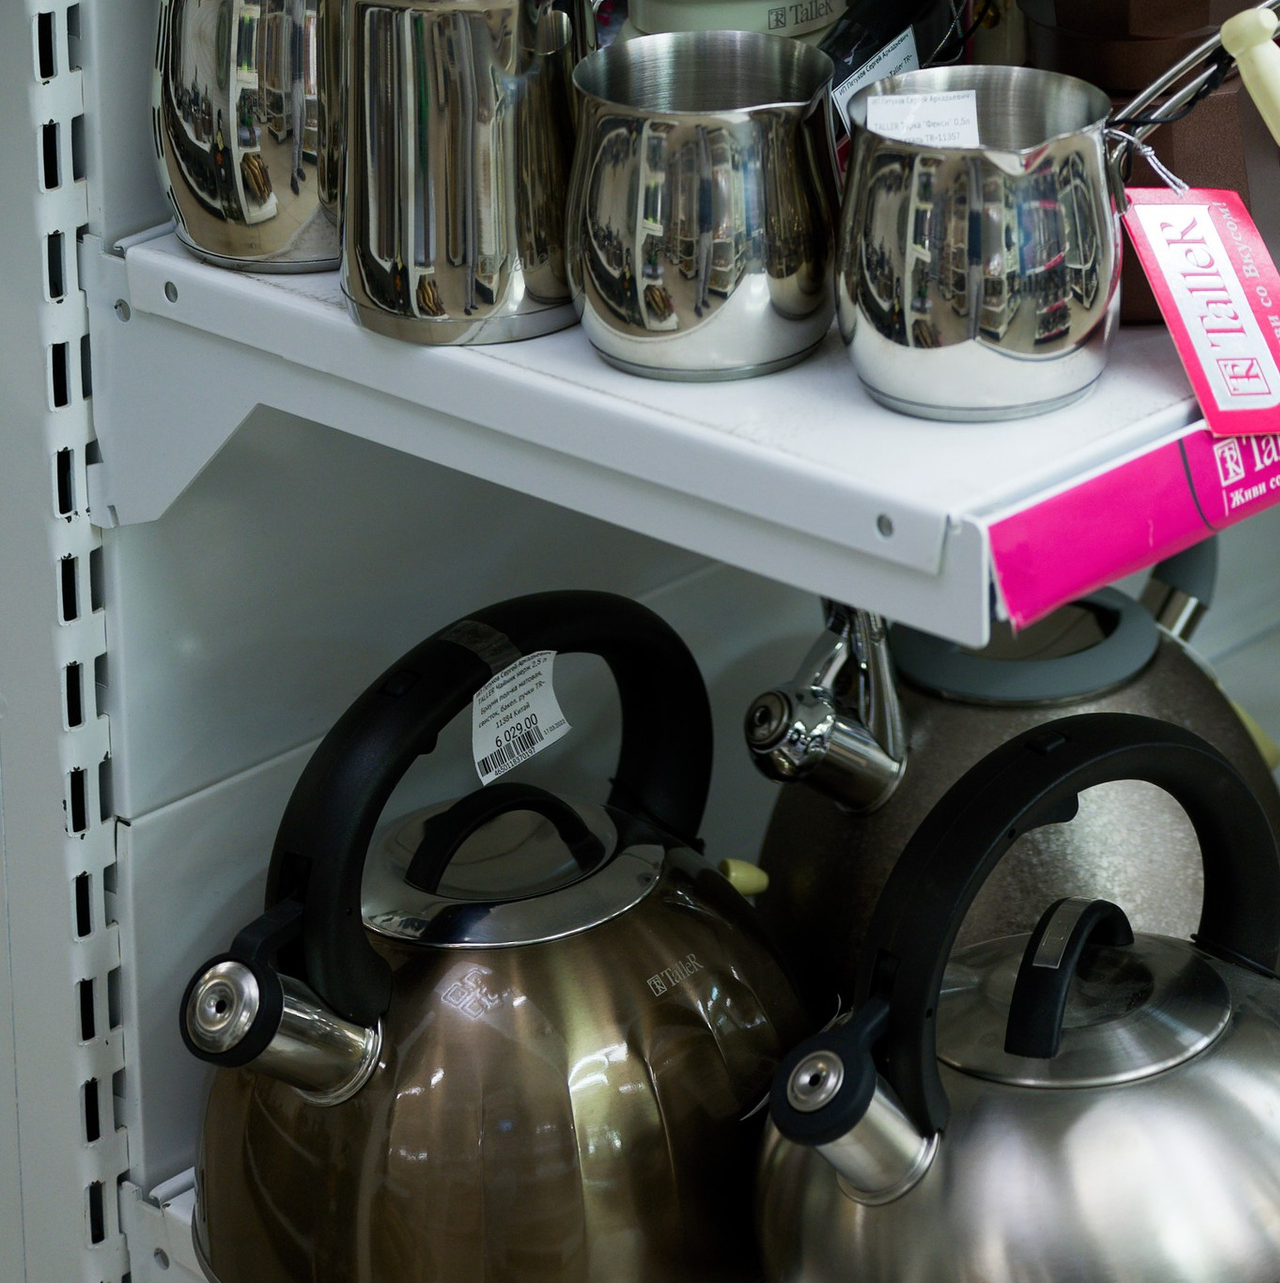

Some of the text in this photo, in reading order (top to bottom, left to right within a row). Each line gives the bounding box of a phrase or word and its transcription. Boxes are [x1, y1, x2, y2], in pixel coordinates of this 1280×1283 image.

[839, 86, 848, 96] ИП
[865, 55, 883, 73] Сергей
[1212, 201, 1260, 279] Вкусом!
[1159, 216, 1248, 349] TalleR
[1257, 286, 1273, 308] со
[1229, 485, 1266, 509] Живи
[478, 688, 496, 705] TALLER
[514, 703, 531, 717] Китай
[495, 713, 538, 748] 6 029.00
[661, 953, 704, 986] TalleR
